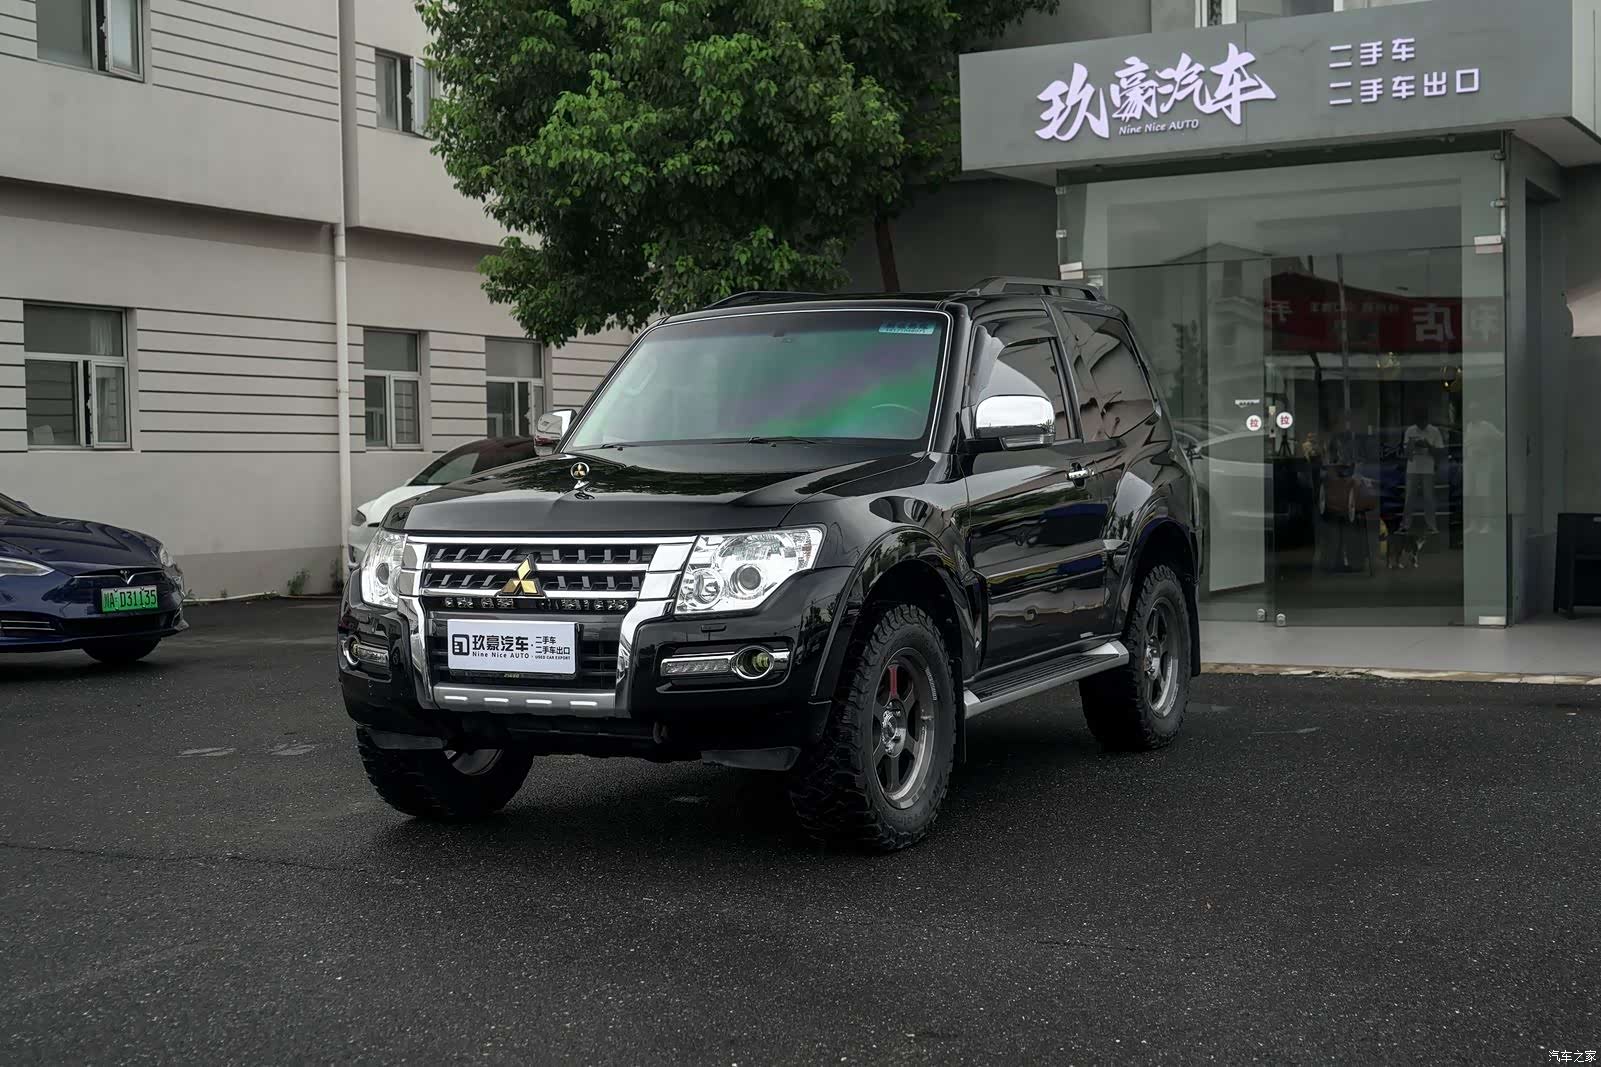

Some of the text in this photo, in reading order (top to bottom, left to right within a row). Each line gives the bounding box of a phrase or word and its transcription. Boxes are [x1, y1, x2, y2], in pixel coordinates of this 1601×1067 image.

[1329, 37, 1416, 70] 二手车
[1034, 42, 1277, 142] 玖豪汽车
[1328, 67, 1480, 106] 二手车出口
[1118, 118, 1200, 136] Nine Nice AUTO
[119, 589, 157, 608] D31135
[472, 634, 529, 652] 玖豪汽车
[535, 635, 557, 645] 二手车
[491, 651, 507, 659] Nice
[535, 645, 571, 655] 二手车出口
